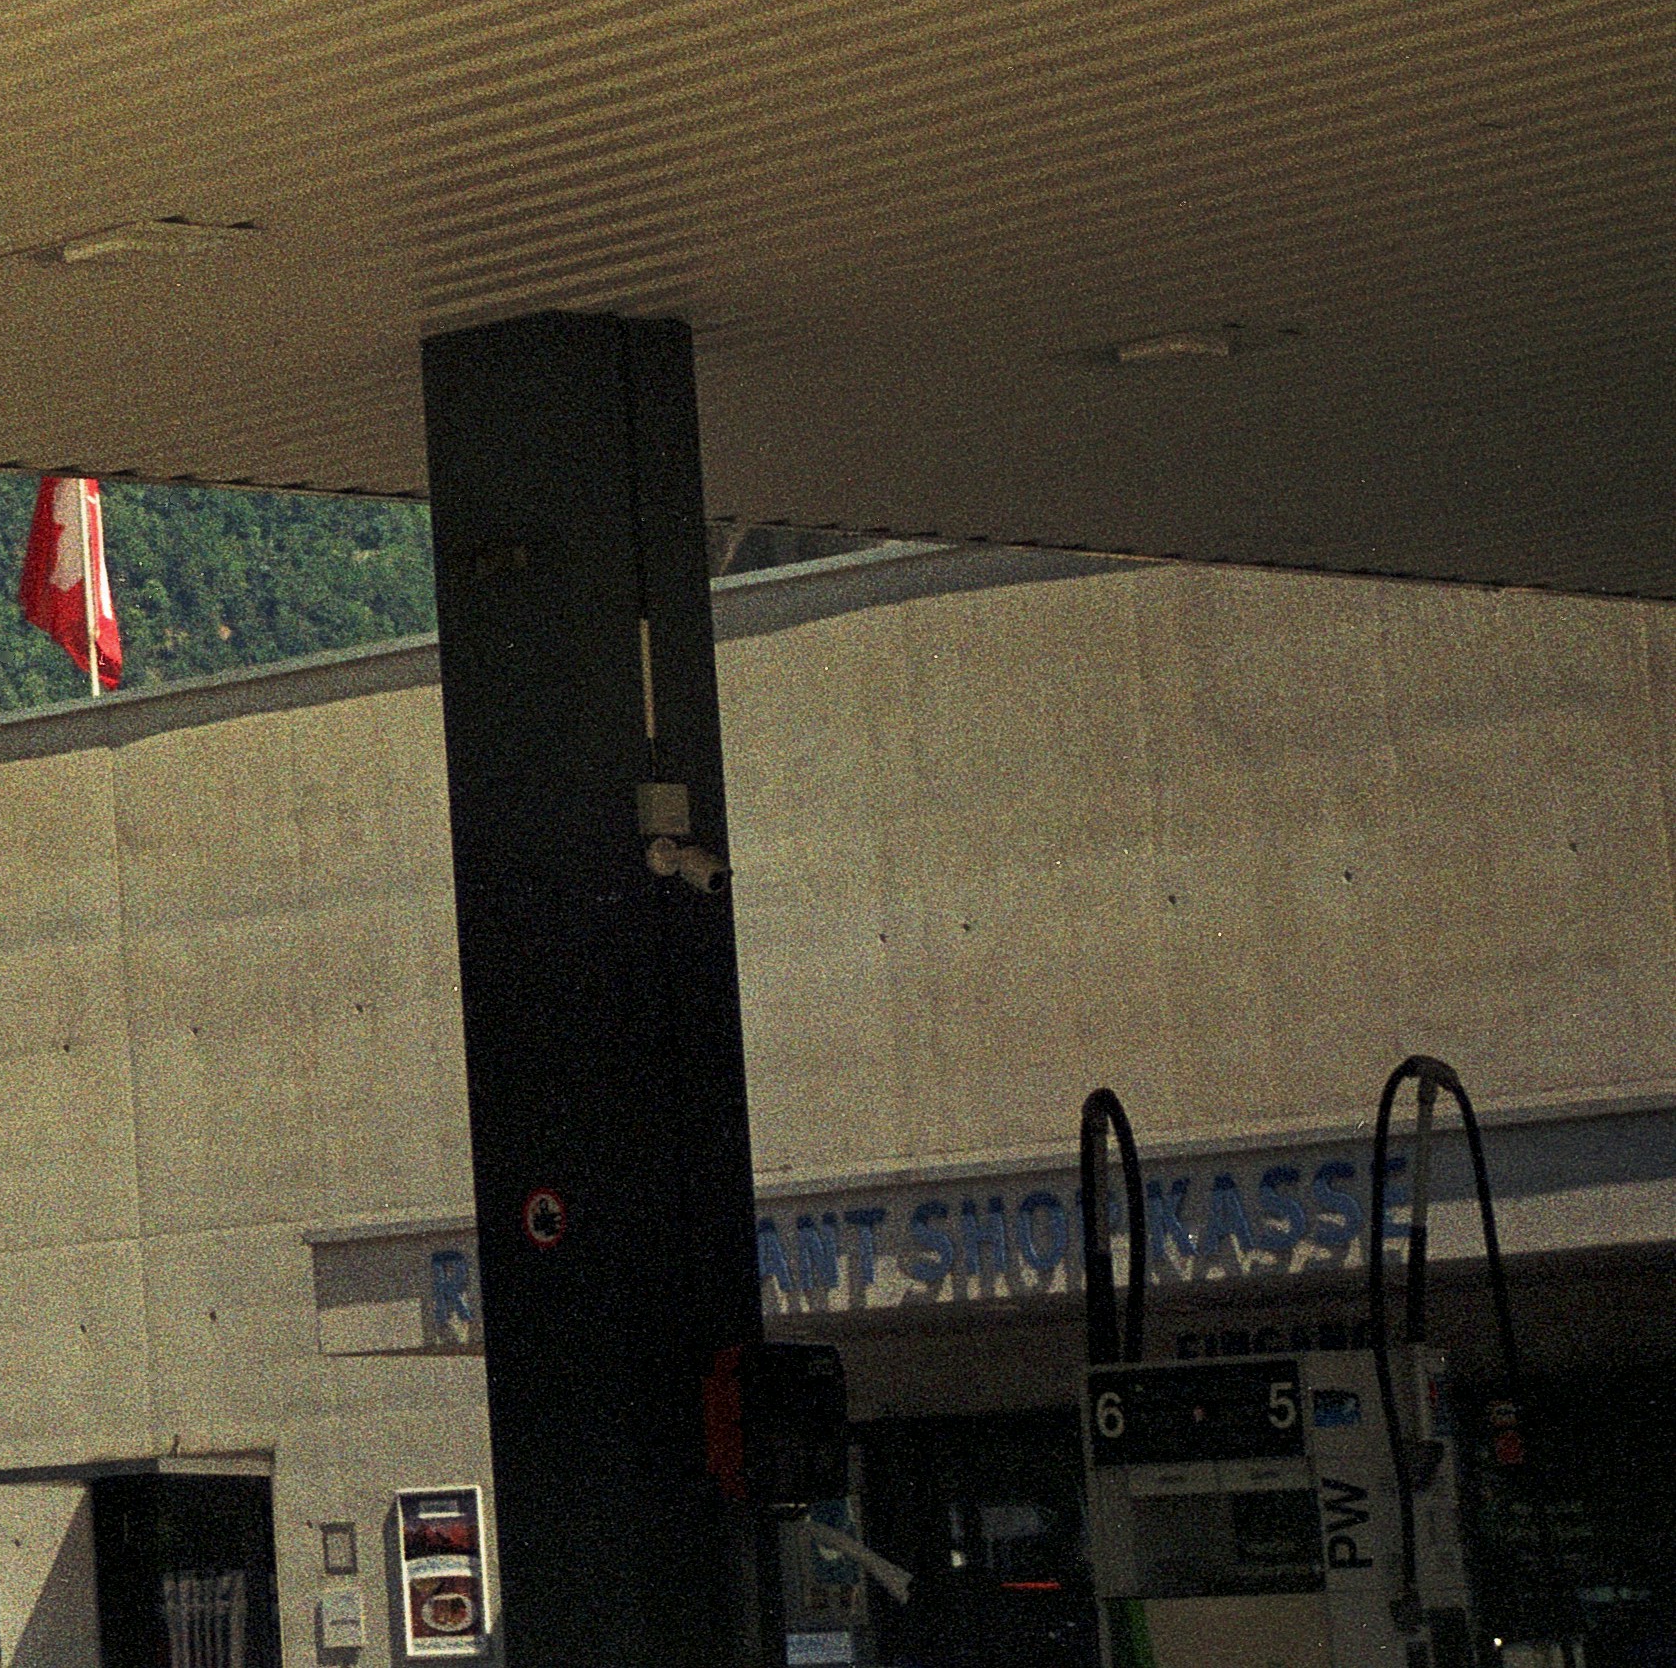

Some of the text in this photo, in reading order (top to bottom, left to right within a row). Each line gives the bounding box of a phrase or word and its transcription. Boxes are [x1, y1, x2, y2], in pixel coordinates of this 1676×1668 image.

[1145, 1157, 1413, 1259] KASSE
[1097, 1392, 1125, 1438] 6
[1268, 1382, 1297, 1429] 5
[1322, 1477, 1373, 1569] PW
